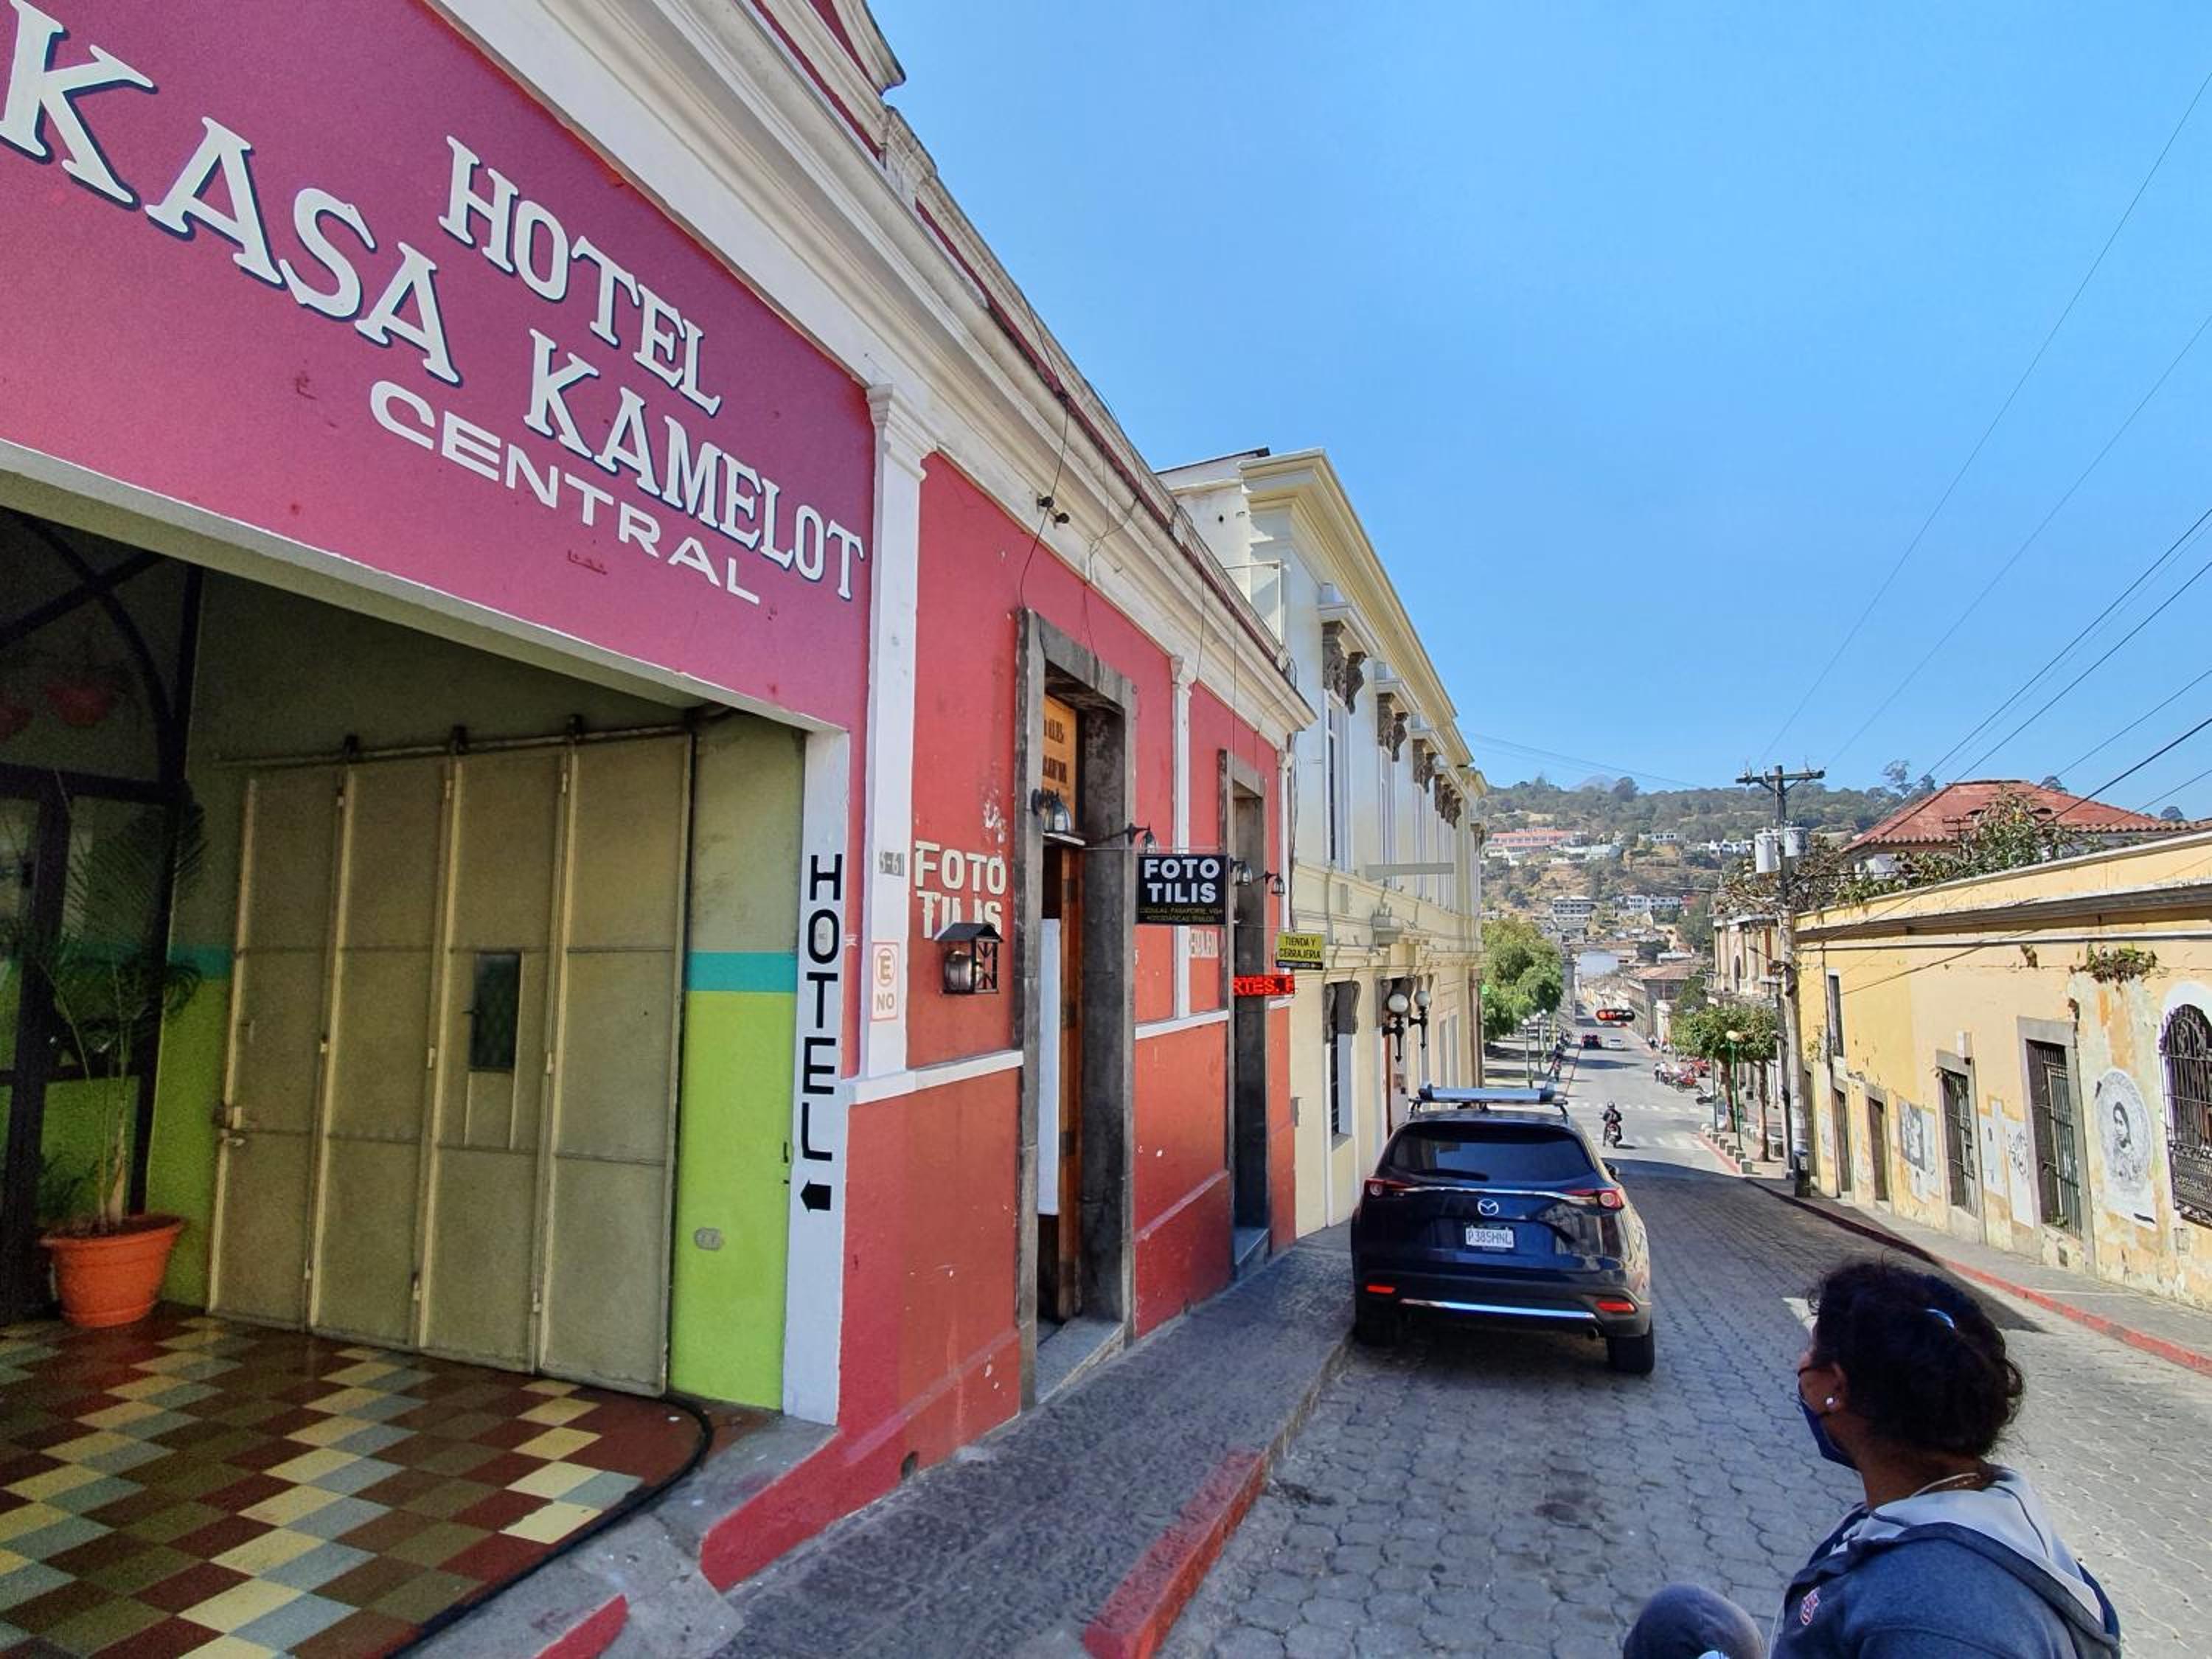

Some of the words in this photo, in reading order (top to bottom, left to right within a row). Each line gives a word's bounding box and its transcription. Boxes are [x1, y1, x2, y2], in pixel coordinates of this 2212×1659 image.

[0, 0, 460, 386] KASA
[524, 328, 864, 602] KAMELOT
[438, 135, 722, 417] HOTEL
[369, 380, 760, 605] CENTRAL
[915, 840, 1006, 894] FOTO
[1144, 858, 1220, 879] FOTO
[1147, 883, 1217, 903] TILIS
[1285, 936, 1309, 947] TIENDA
[1310, 937, 1316, 947] Y
[800, 853, 843, 1162] HOTEL
[876, 993, 895, 1011] NO
